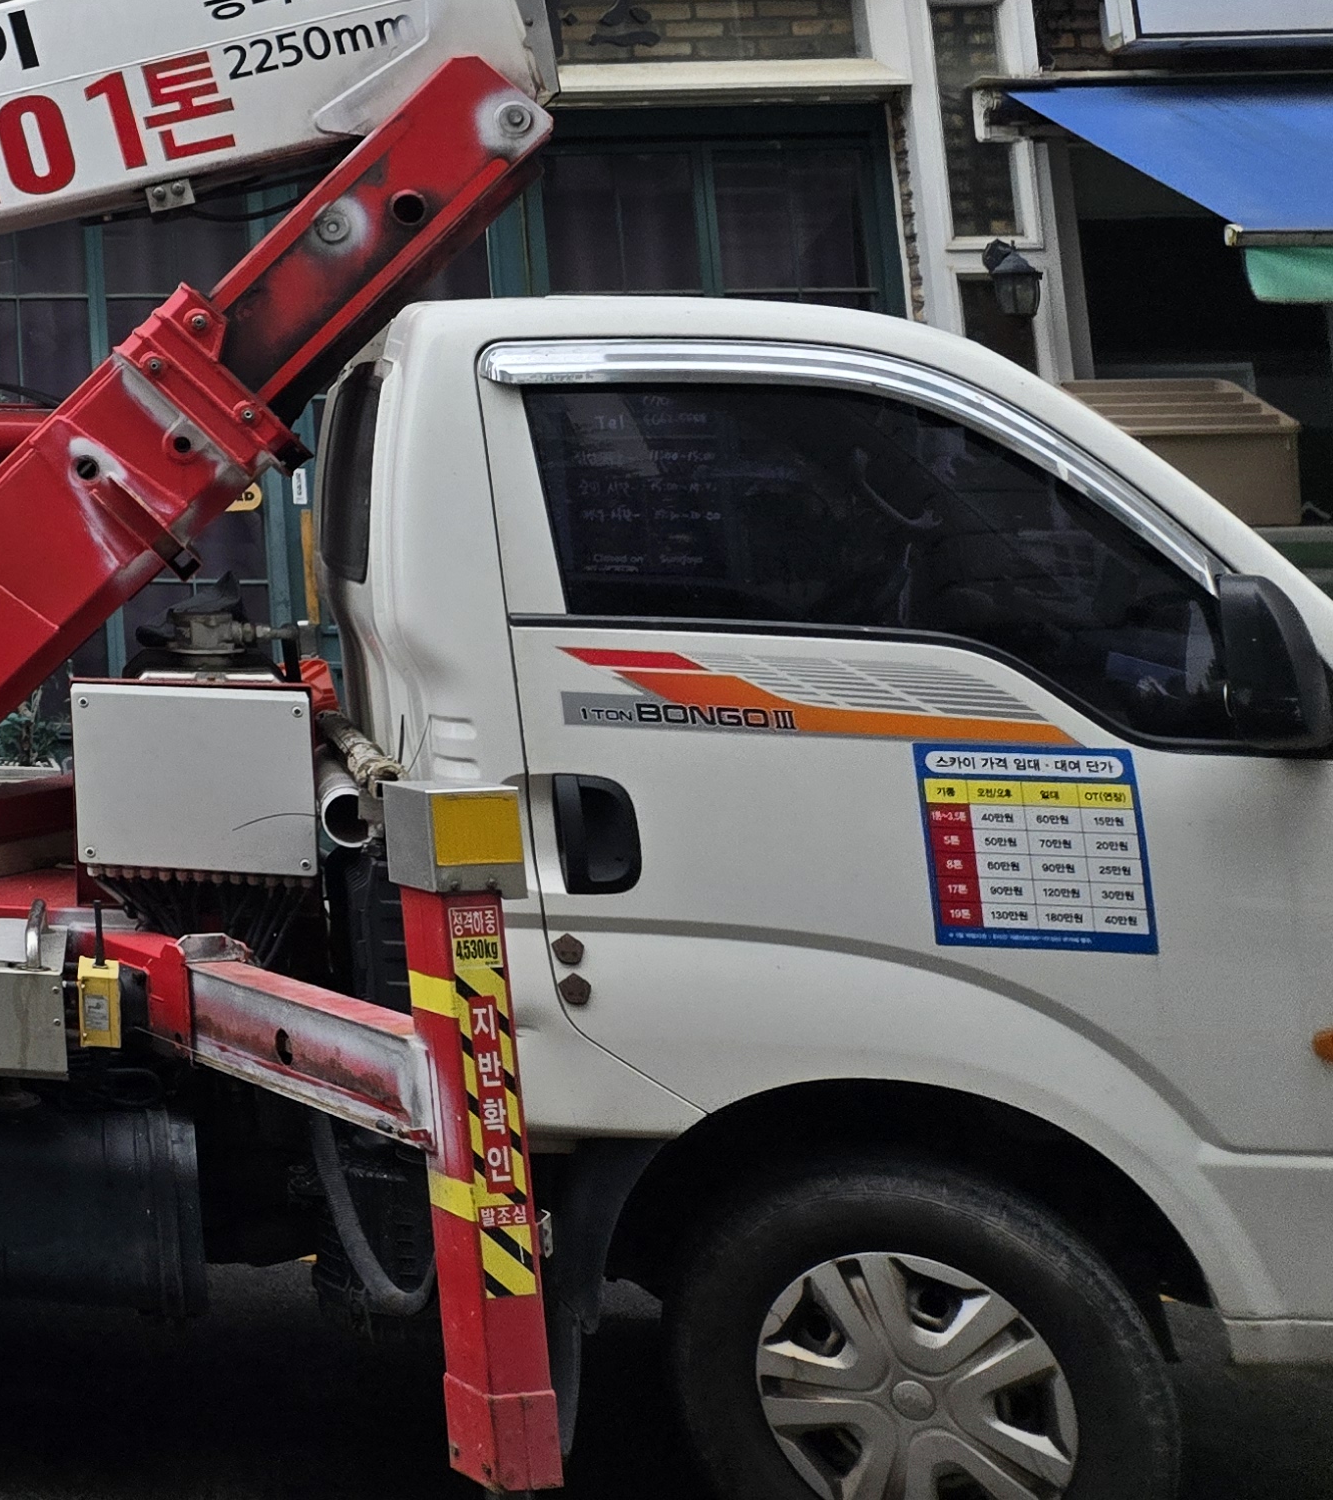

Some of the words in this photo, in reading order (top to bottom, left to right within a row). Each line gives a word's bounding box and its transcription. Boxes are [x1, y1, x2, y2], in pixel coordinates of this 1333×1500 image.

[223, 14, 418, 80] 2250mm
[88, 49, 235, 170] 1톤
[635, 703, 769, 728] BONGO
[936, 756, 975, 770] 스카이
[981, 757, 1008, 770] 가격
[1014, 758, 1041, 772] 임대
[1055, 759, 1081, 773] 대여
[1086, 760, 1114, 773] 단가
[981, 813, 1014, 823] 40만원
[1036, 814, 1069, 825] 60만원
[1093, 816, 1125, 827] 15만원
[984, 837, 1017, 847] 50만원
[1039, 839, 1072, 849] 70만원
[1095, 840, 1128, 851] 20만원
[1042, 863, 1075, 874] 90만원
[1098, 865, 1131, 876] 25만원
[947, 884, 968, 894] 17톤
[990, 886, 1023, 896] 90만원
[1043, 888, 1080, 898] 120만원
[1101, 890, 1134, 901] 30만원
[990, 911, 1028, 921] 130만원
[1045, 912, 1083, 923] 180만원
[1104, 915, 1138, 926] 40만원
[453, 910, 496, 936] 정격하중
[481, 1205, 527, 1227] 발조심
